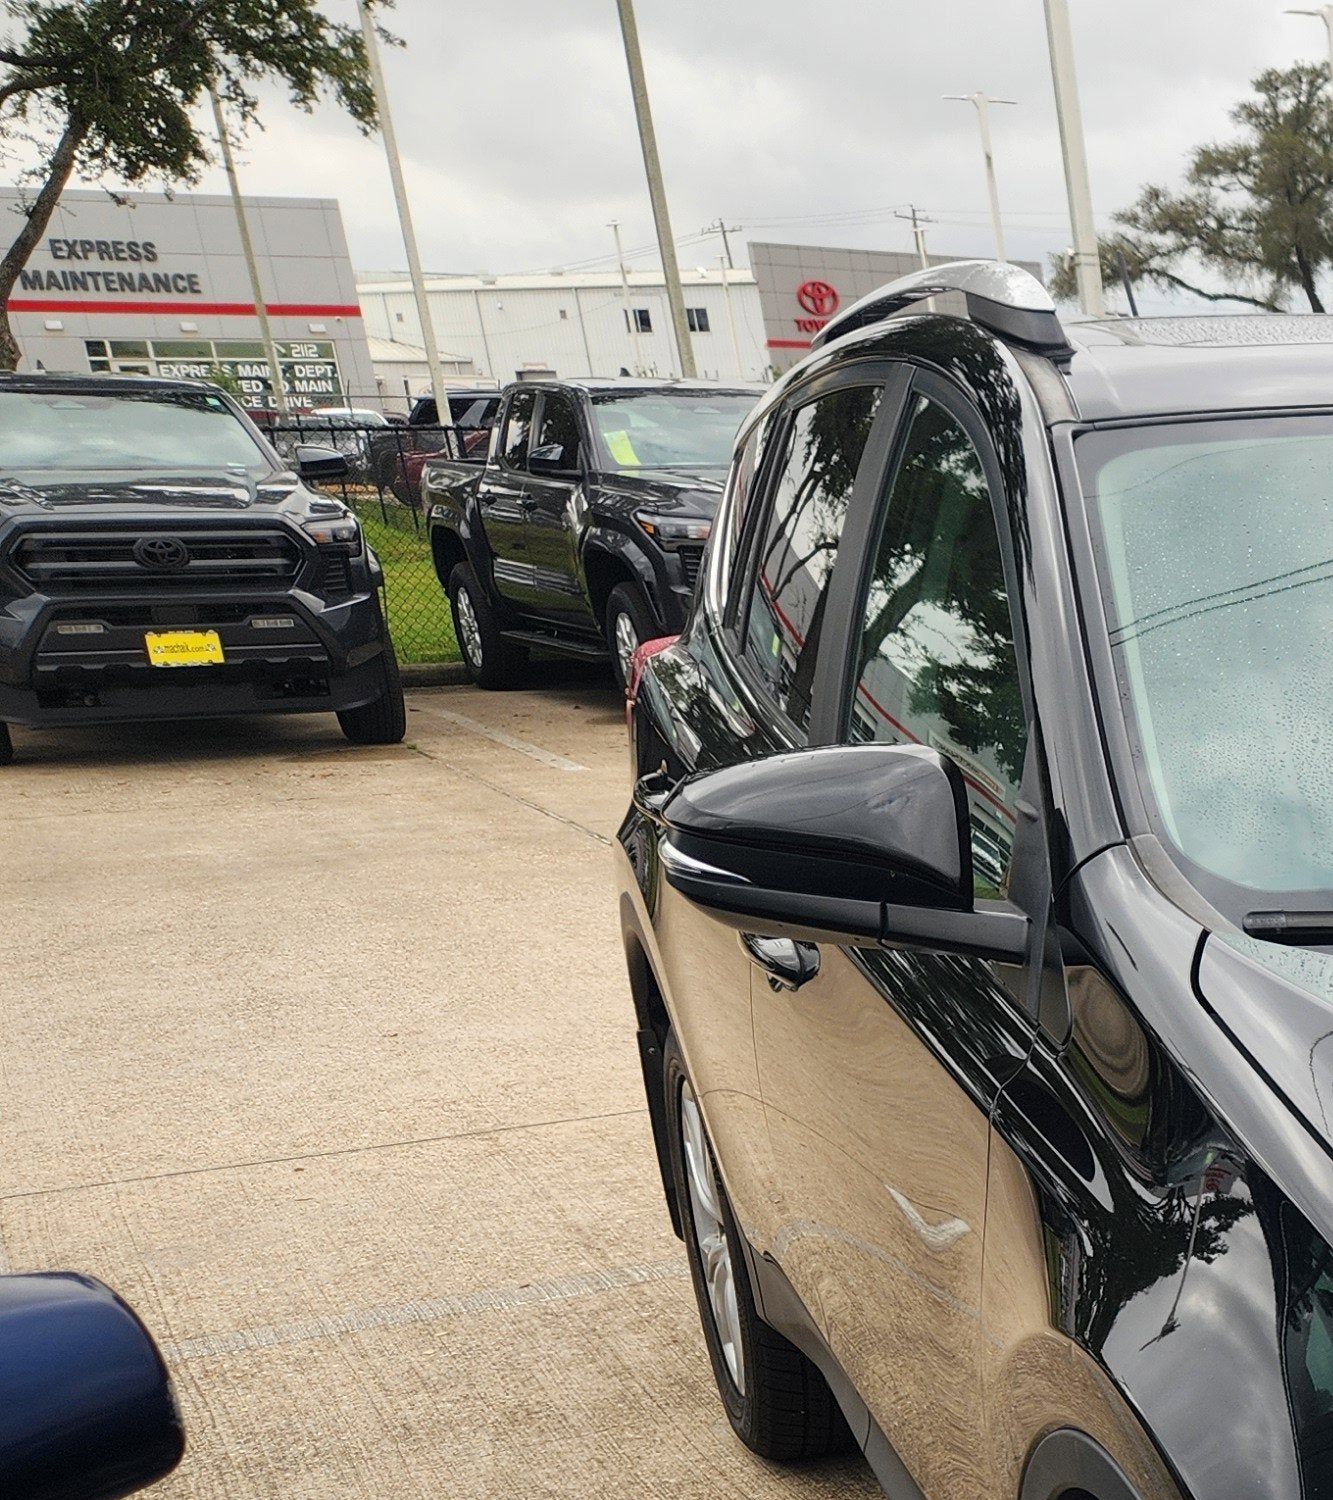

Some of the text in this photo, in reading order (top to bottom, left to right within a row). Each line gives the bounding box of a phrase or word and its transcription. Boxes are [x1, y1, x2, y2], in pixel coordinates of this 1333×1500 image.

[48, 238, 158, 263] EXPRESS
[20, 269, 202, 294] MAINTENANCE
[794, 318, 829, 333] TOY
[290, 343, 319, 358] 2112
[158, 364, 233, 378] EXPRESS
[294, 364, 338, 378] DEPT.
[294, 380, 334, 393] MAIN
